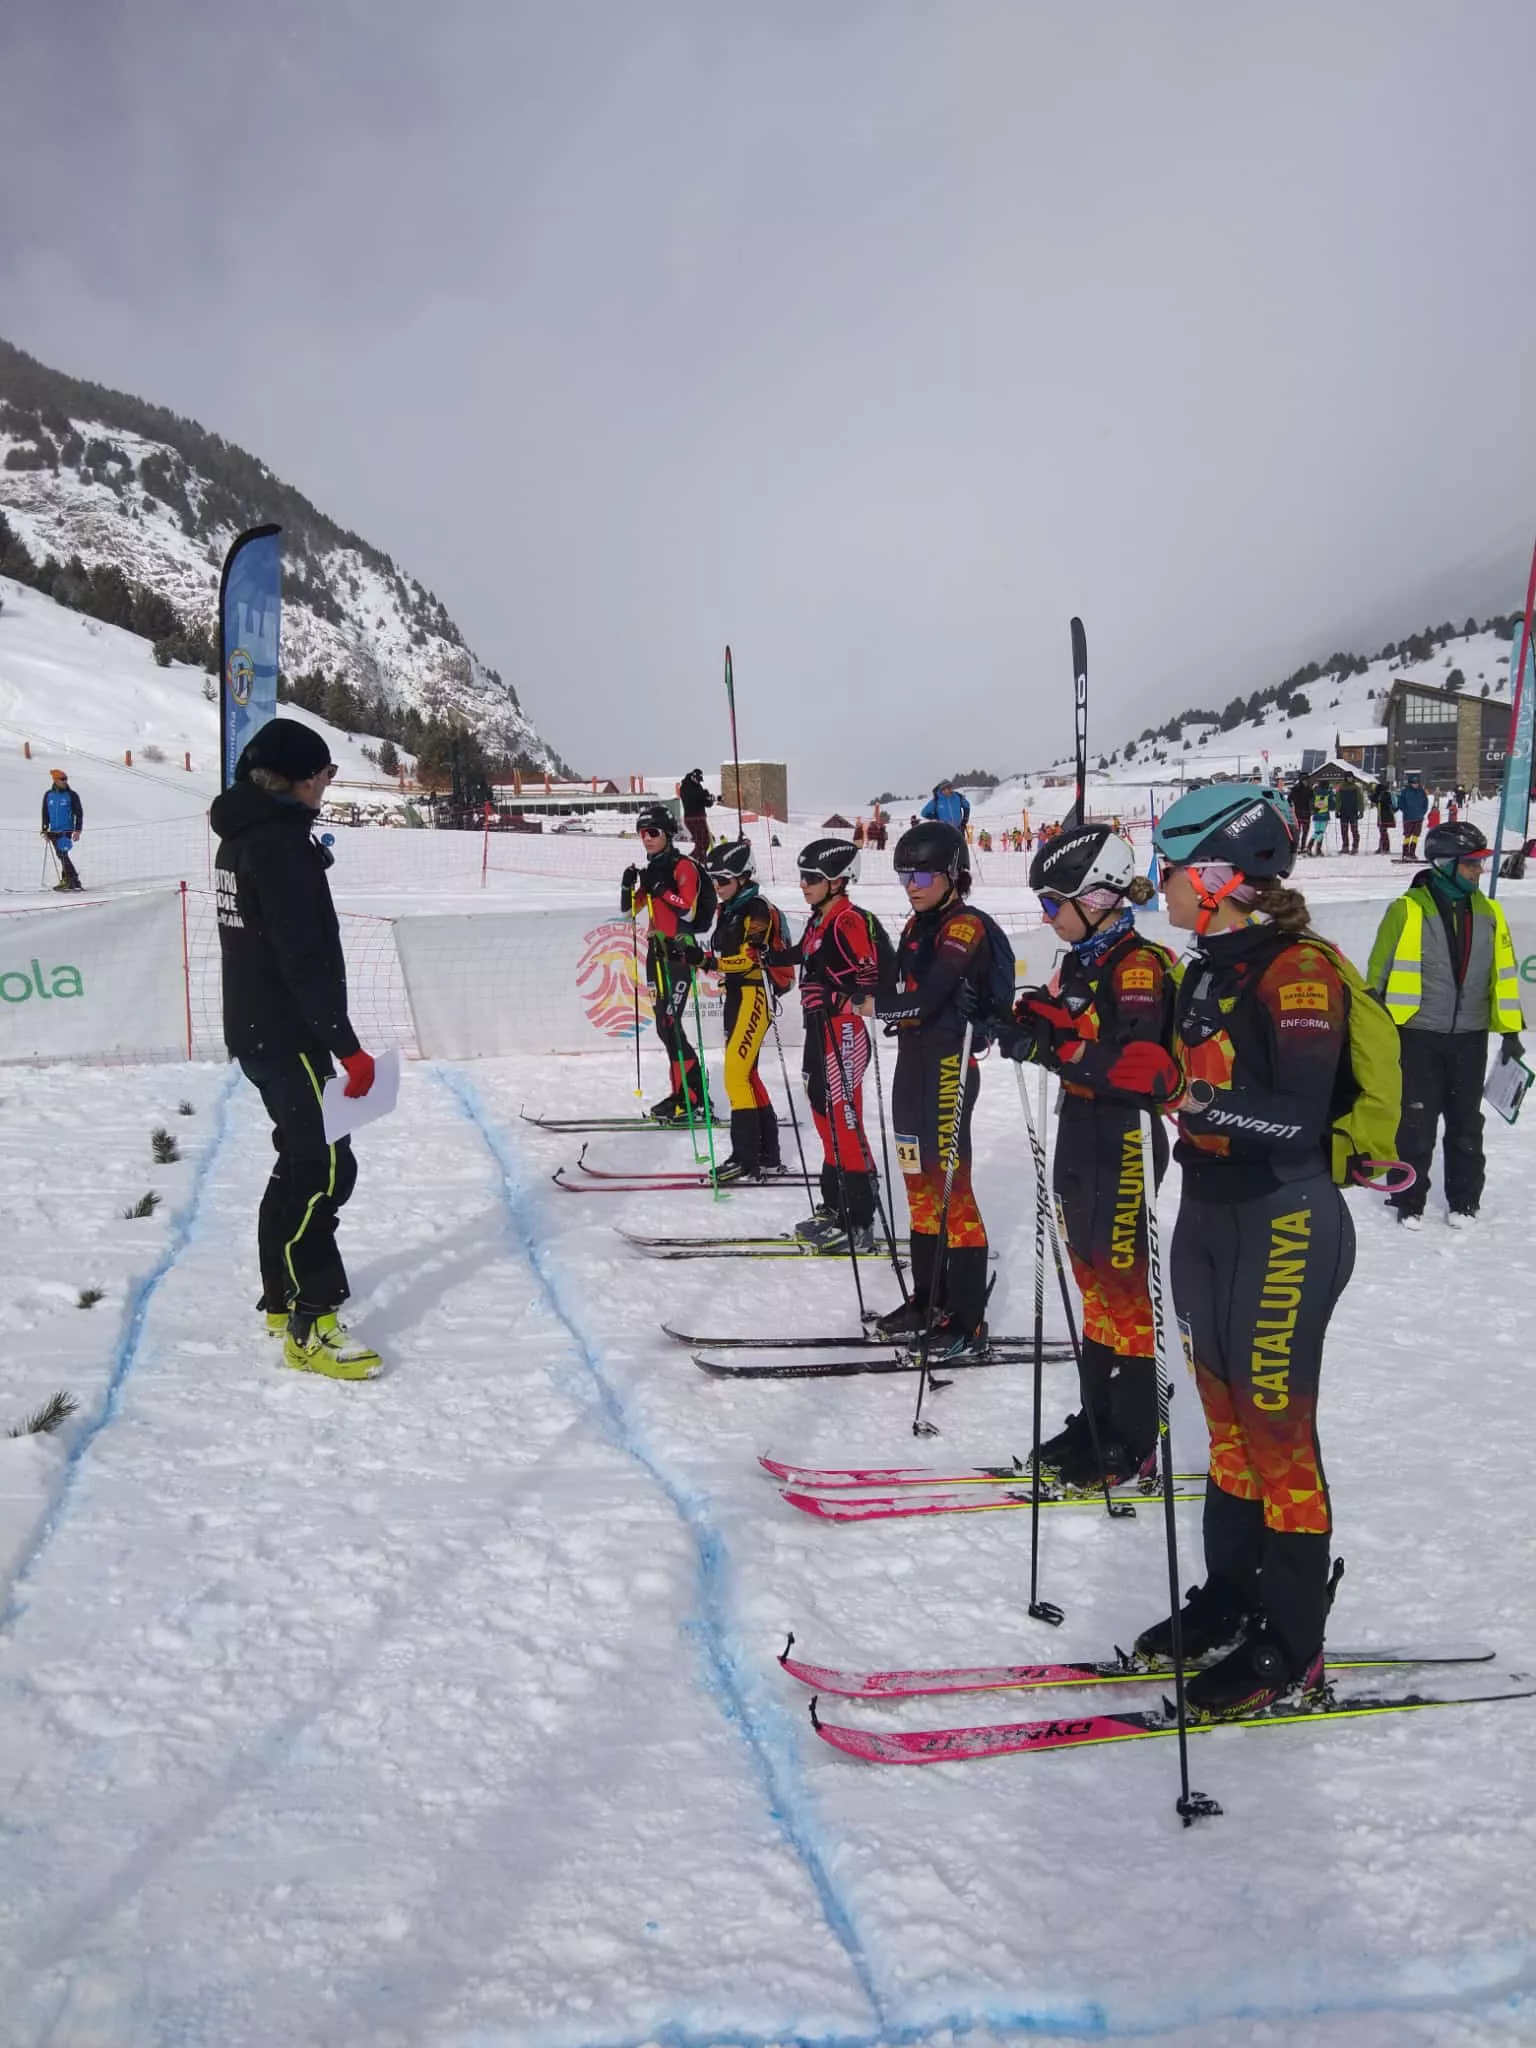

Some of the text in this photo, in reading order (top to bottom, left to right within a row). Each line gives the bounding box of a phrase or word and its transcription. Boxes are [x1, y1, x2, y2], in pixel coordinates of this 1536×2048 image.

[1043, 832, 1101, 873] DYNAFIT
[0, 958, 84, 1002] ola
[738, 986, 766, 1060] DYNAFIT
[1280, 1017, 1330, 1030] ENFORMA
[938, 1053, 961, 1172] CATALUNYA
[1206, 1109, 1302, 1139] DYNAFIT
[1111, 1127, 1145, 1270] CATALUNYA
[1148, 1207, 1168, 1354] DYNAFIT
[1252, 1208, 1312, 1412] CATALUNYA
